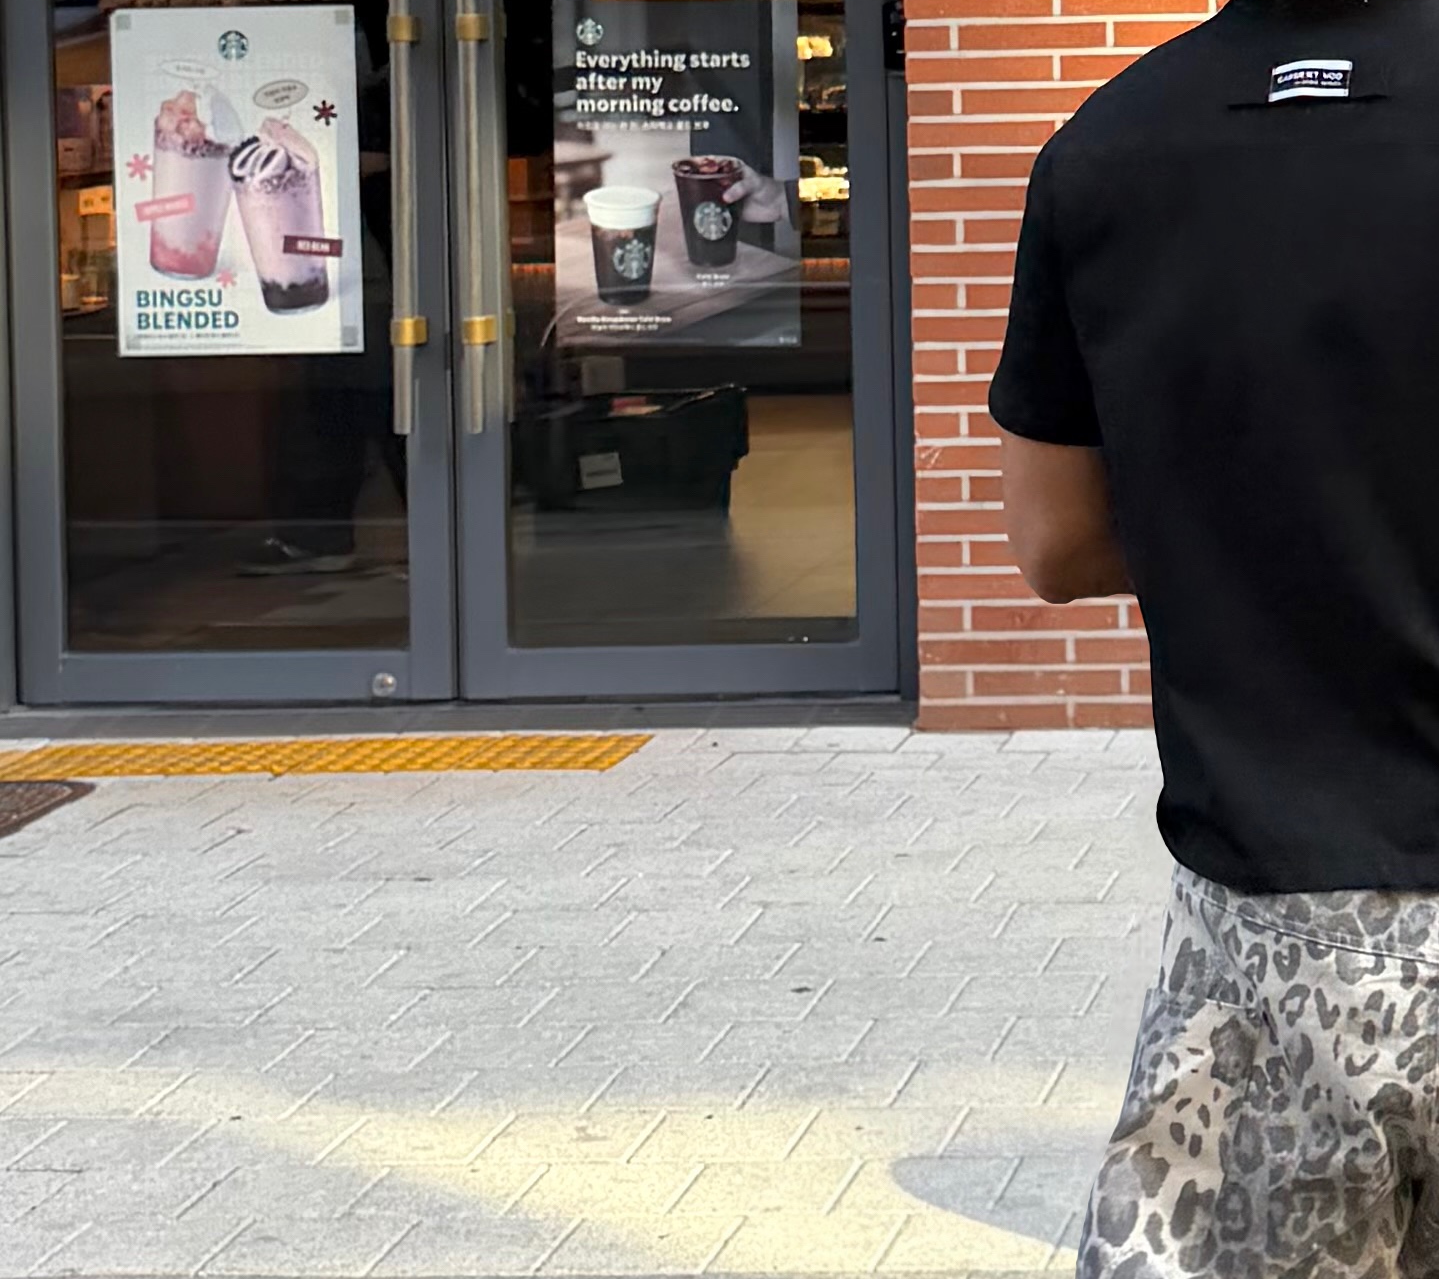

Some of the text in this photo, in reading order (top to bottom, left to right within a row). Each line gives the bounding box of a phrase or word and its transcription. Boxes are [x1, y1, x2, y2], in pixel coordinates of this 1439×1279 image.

[576, 49, 751, 72] Everything starts
[576, 72, 663, 93] after my
[576, 94, 739, 117] morning coffee.
[136, 290, 222, 308] BINGSU
[137, 311, 239, 330] BLENDED
